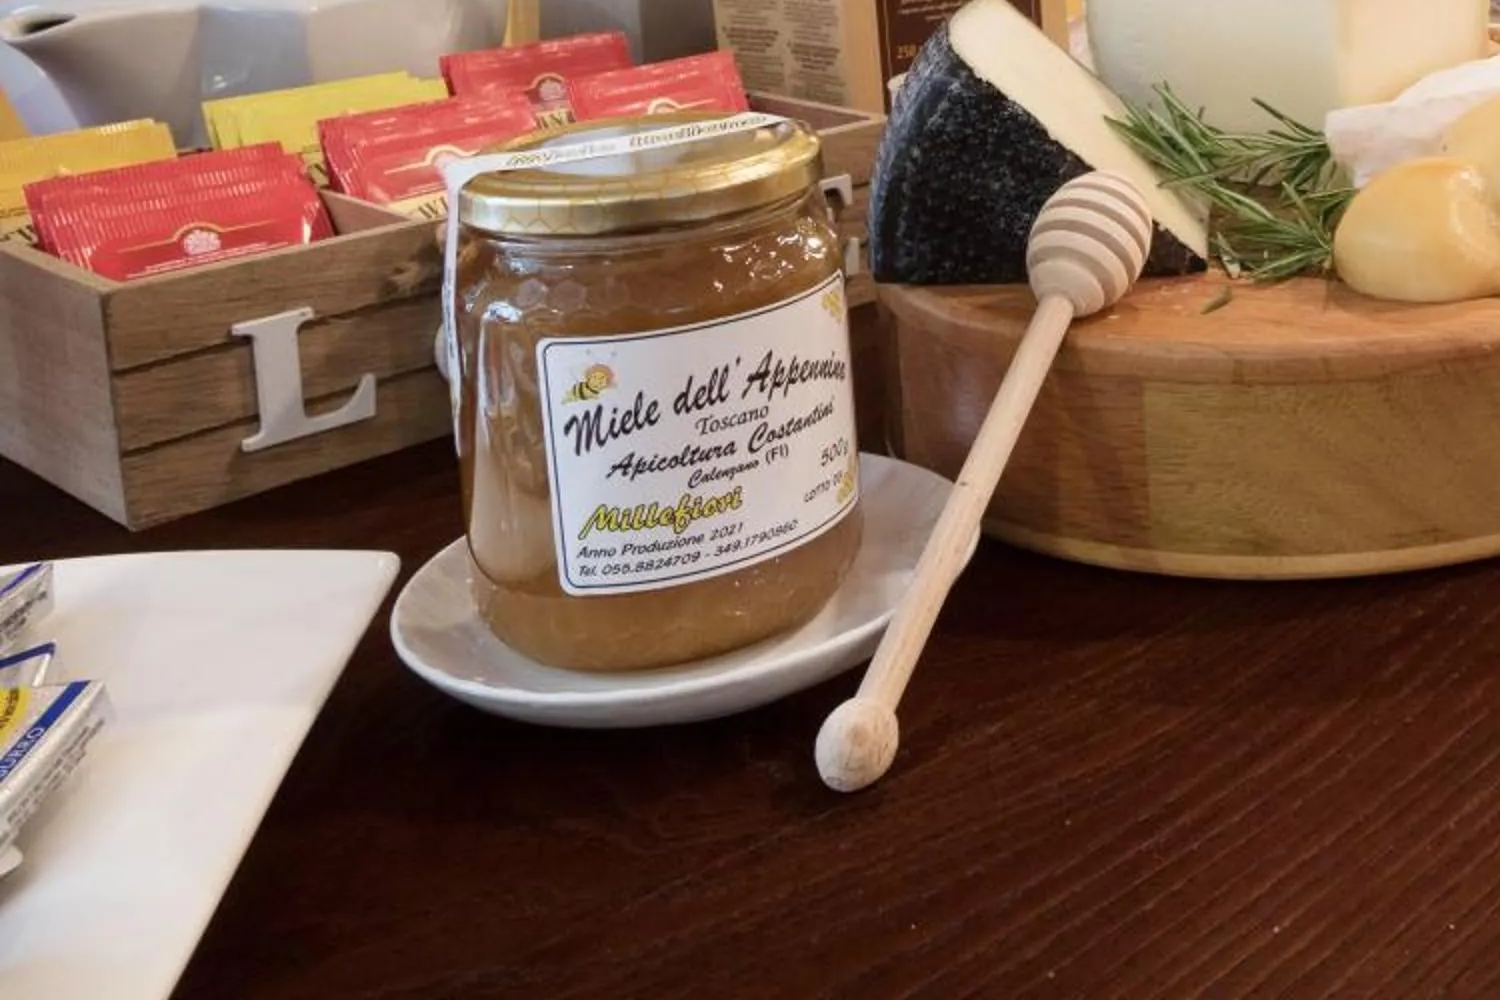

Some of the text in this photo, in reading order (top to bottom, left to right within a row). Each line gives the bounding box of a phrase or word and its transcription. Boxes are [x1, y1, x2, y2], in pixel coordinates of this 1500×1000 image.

[231, 306, 377, 452] L
[564, 390, 660, 457] Miele
[606, 394, 834, 480] Apicoltura Costantini
[695, 405, 769, 436] Toscano
[688, 443, 789, 489] Calenzano (FI)
[578, 486, 743, 540] Millefiori
[577, 522, 745, 560] Anno Produzione 2021
